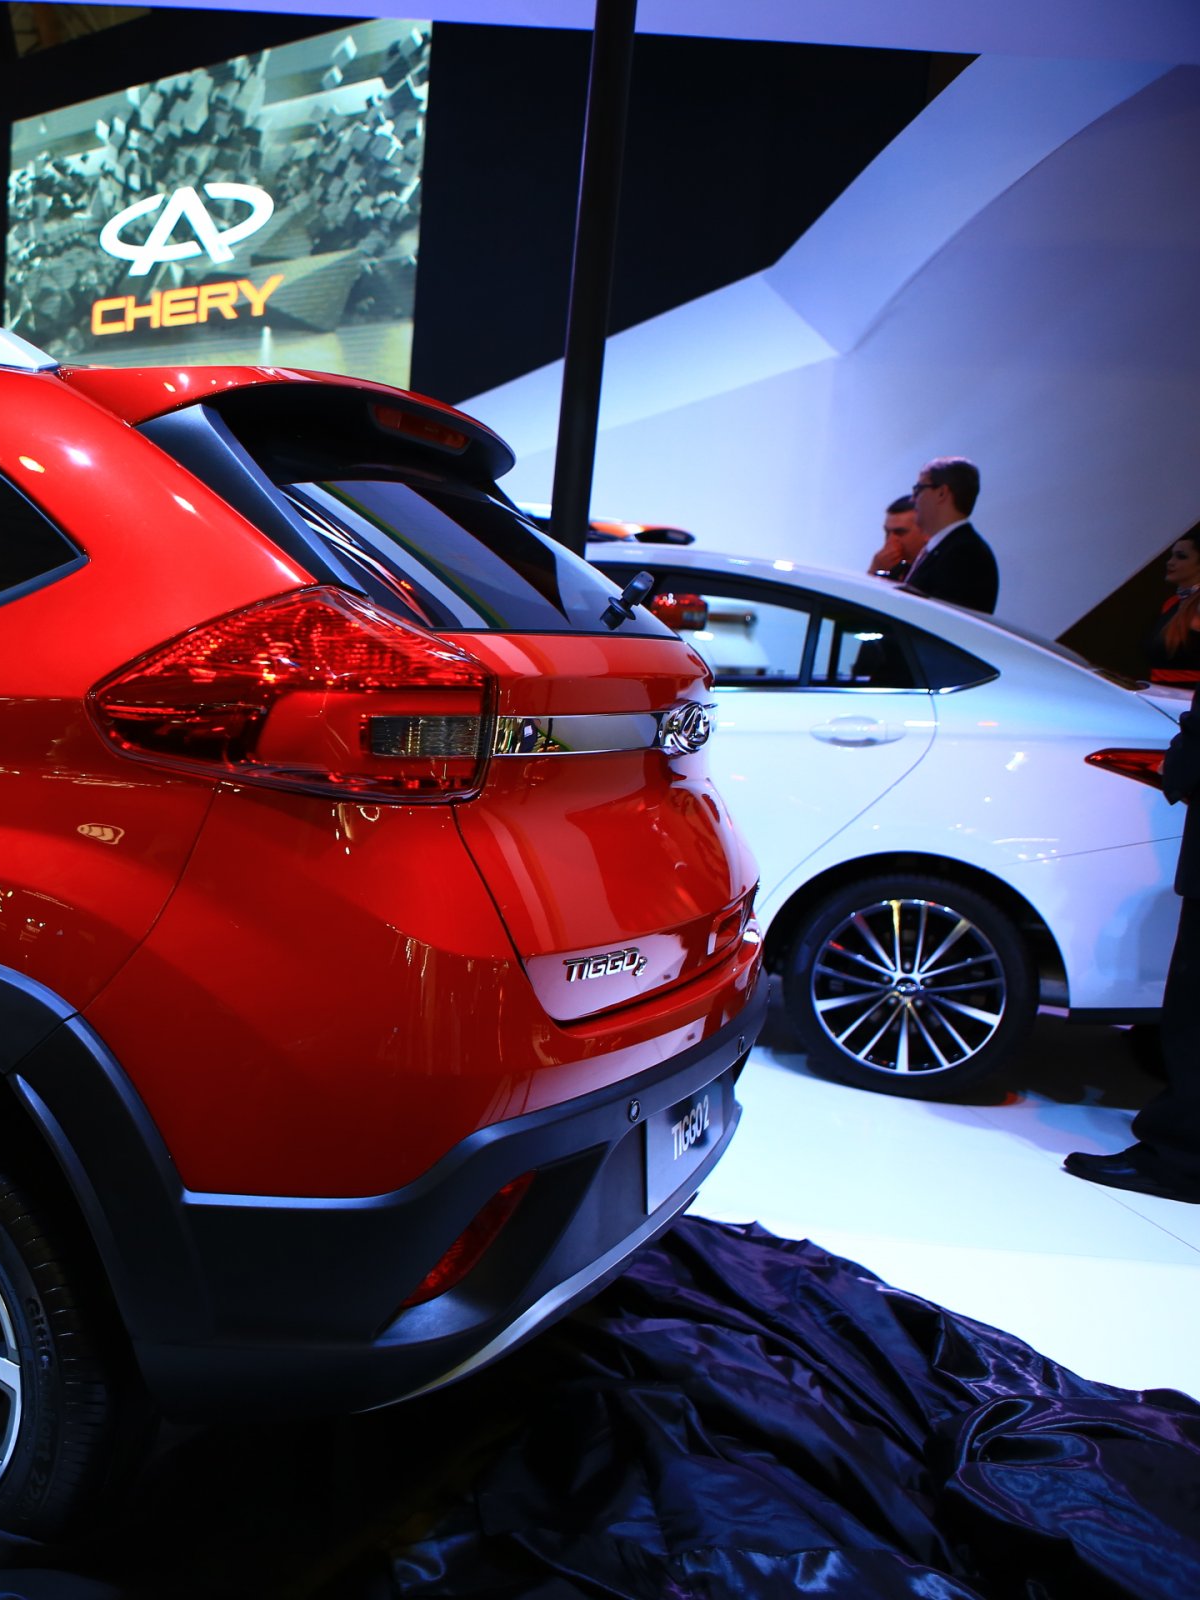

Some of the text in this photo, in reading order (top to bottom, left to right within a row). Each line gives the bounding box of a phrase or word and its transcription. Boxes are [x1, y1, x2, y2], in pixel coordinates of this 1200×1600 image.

[90, 273, 286, 336] CHERY
[671, 1094, 710, 1160] TIGGO 2
